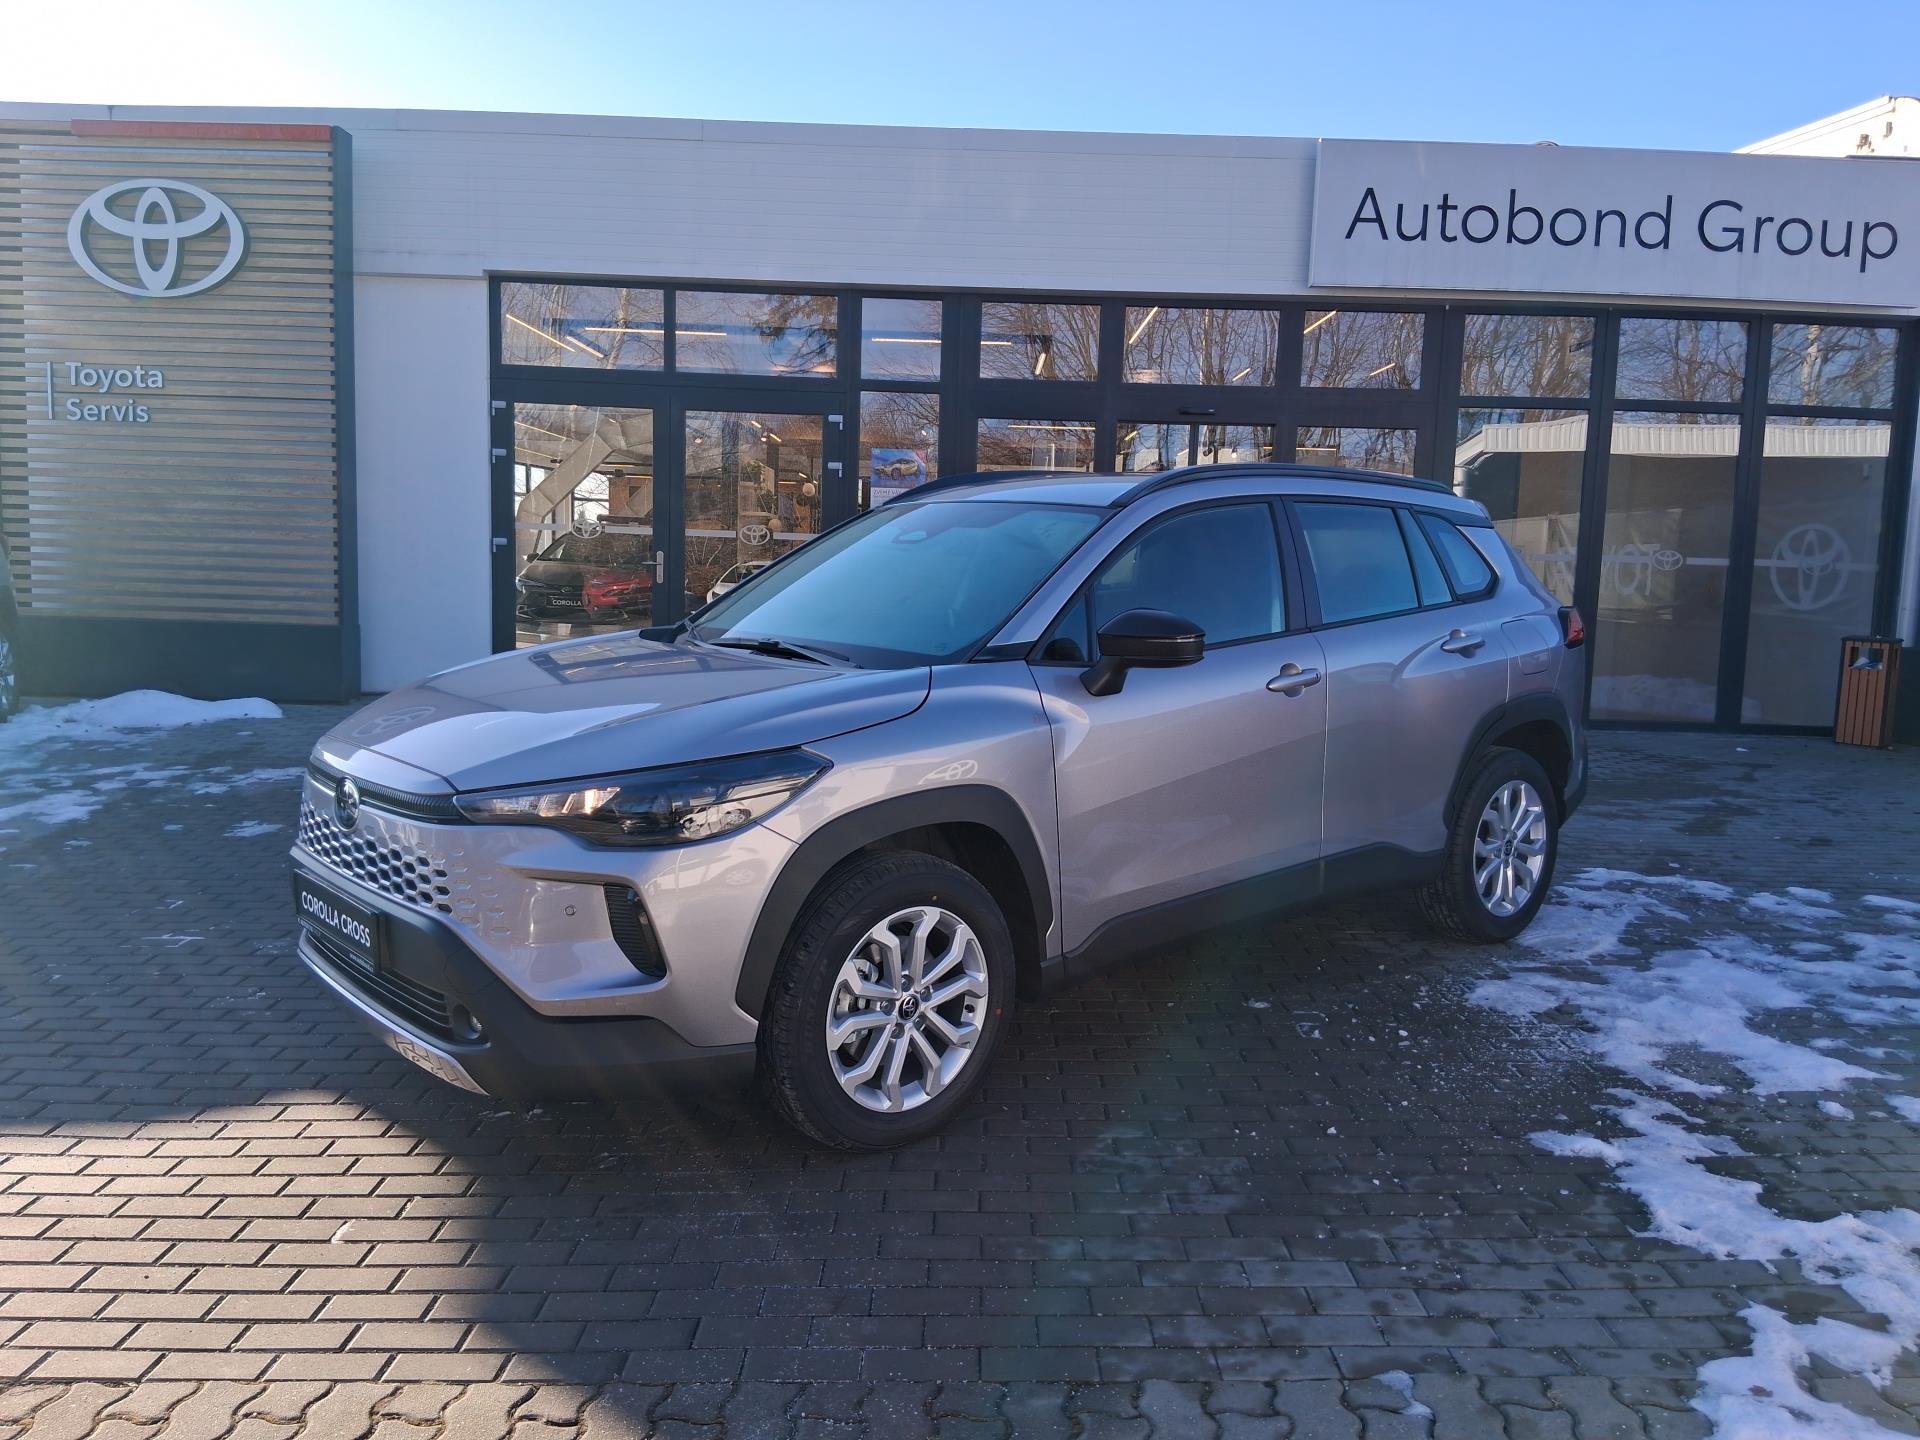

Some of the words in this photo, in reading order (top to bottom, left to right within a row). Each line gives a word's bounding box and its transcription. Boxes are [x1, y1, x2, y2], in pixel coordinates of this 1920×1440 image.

[1344, 187, 1674, 250] Autobond
[1698, 199, 1899, 274] Group
[65, 361, 163, 392] Toyota
[66, 398, 150, 423] Servis
[301, 891, 340, 929] COROLLA
[340, 914, 371, 947] CROSS
